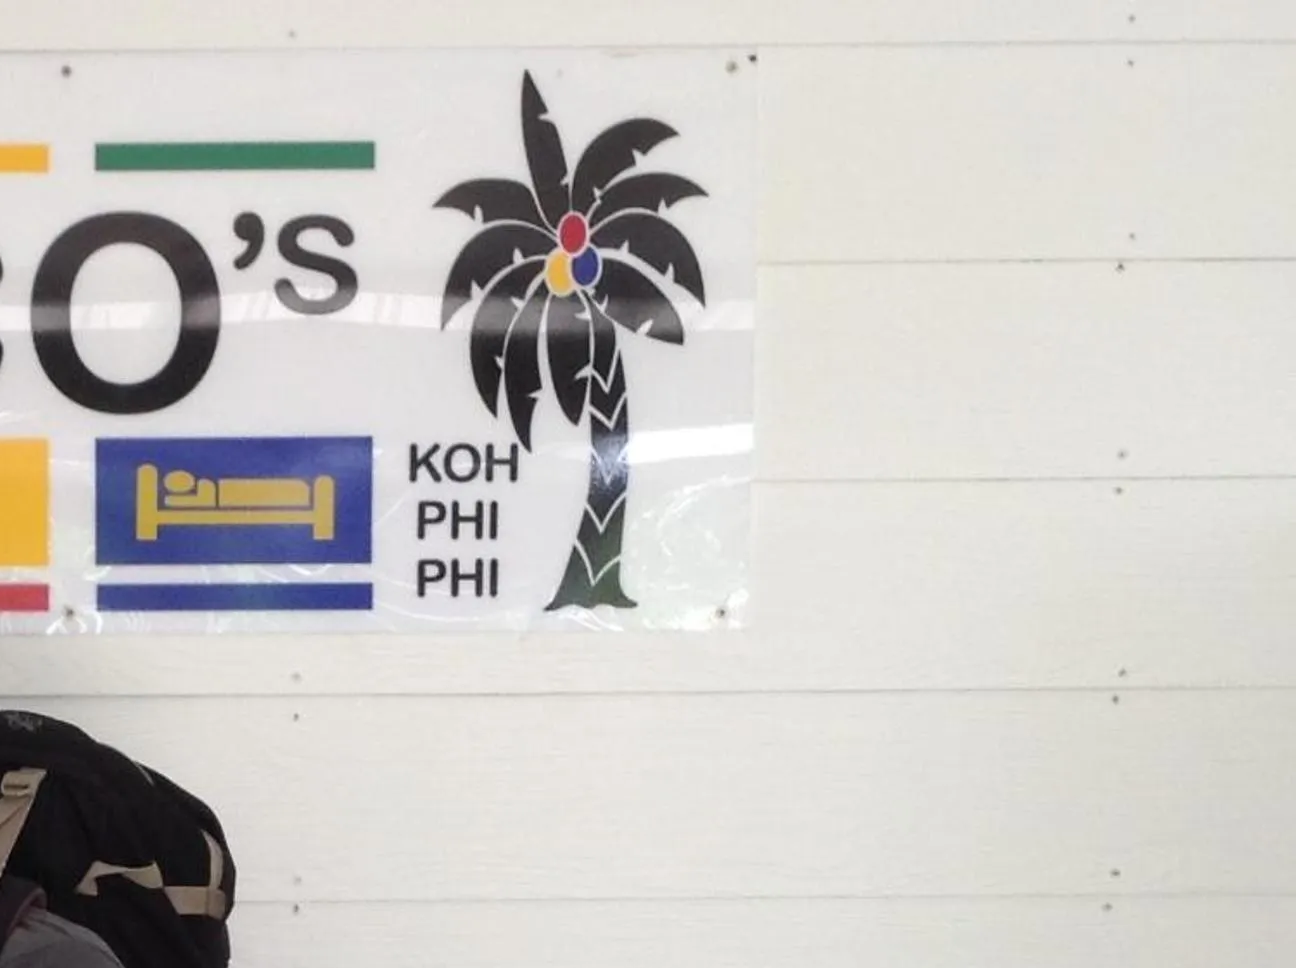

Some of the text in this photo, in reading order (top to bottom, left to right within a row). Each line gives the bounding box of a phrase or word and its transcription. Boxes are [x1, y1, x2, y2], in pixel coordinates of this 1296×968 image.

[408, 442, 520, 484] KOH
[416, 500, 499, 541] PHI
[416, 558, 499, 598] PHI
